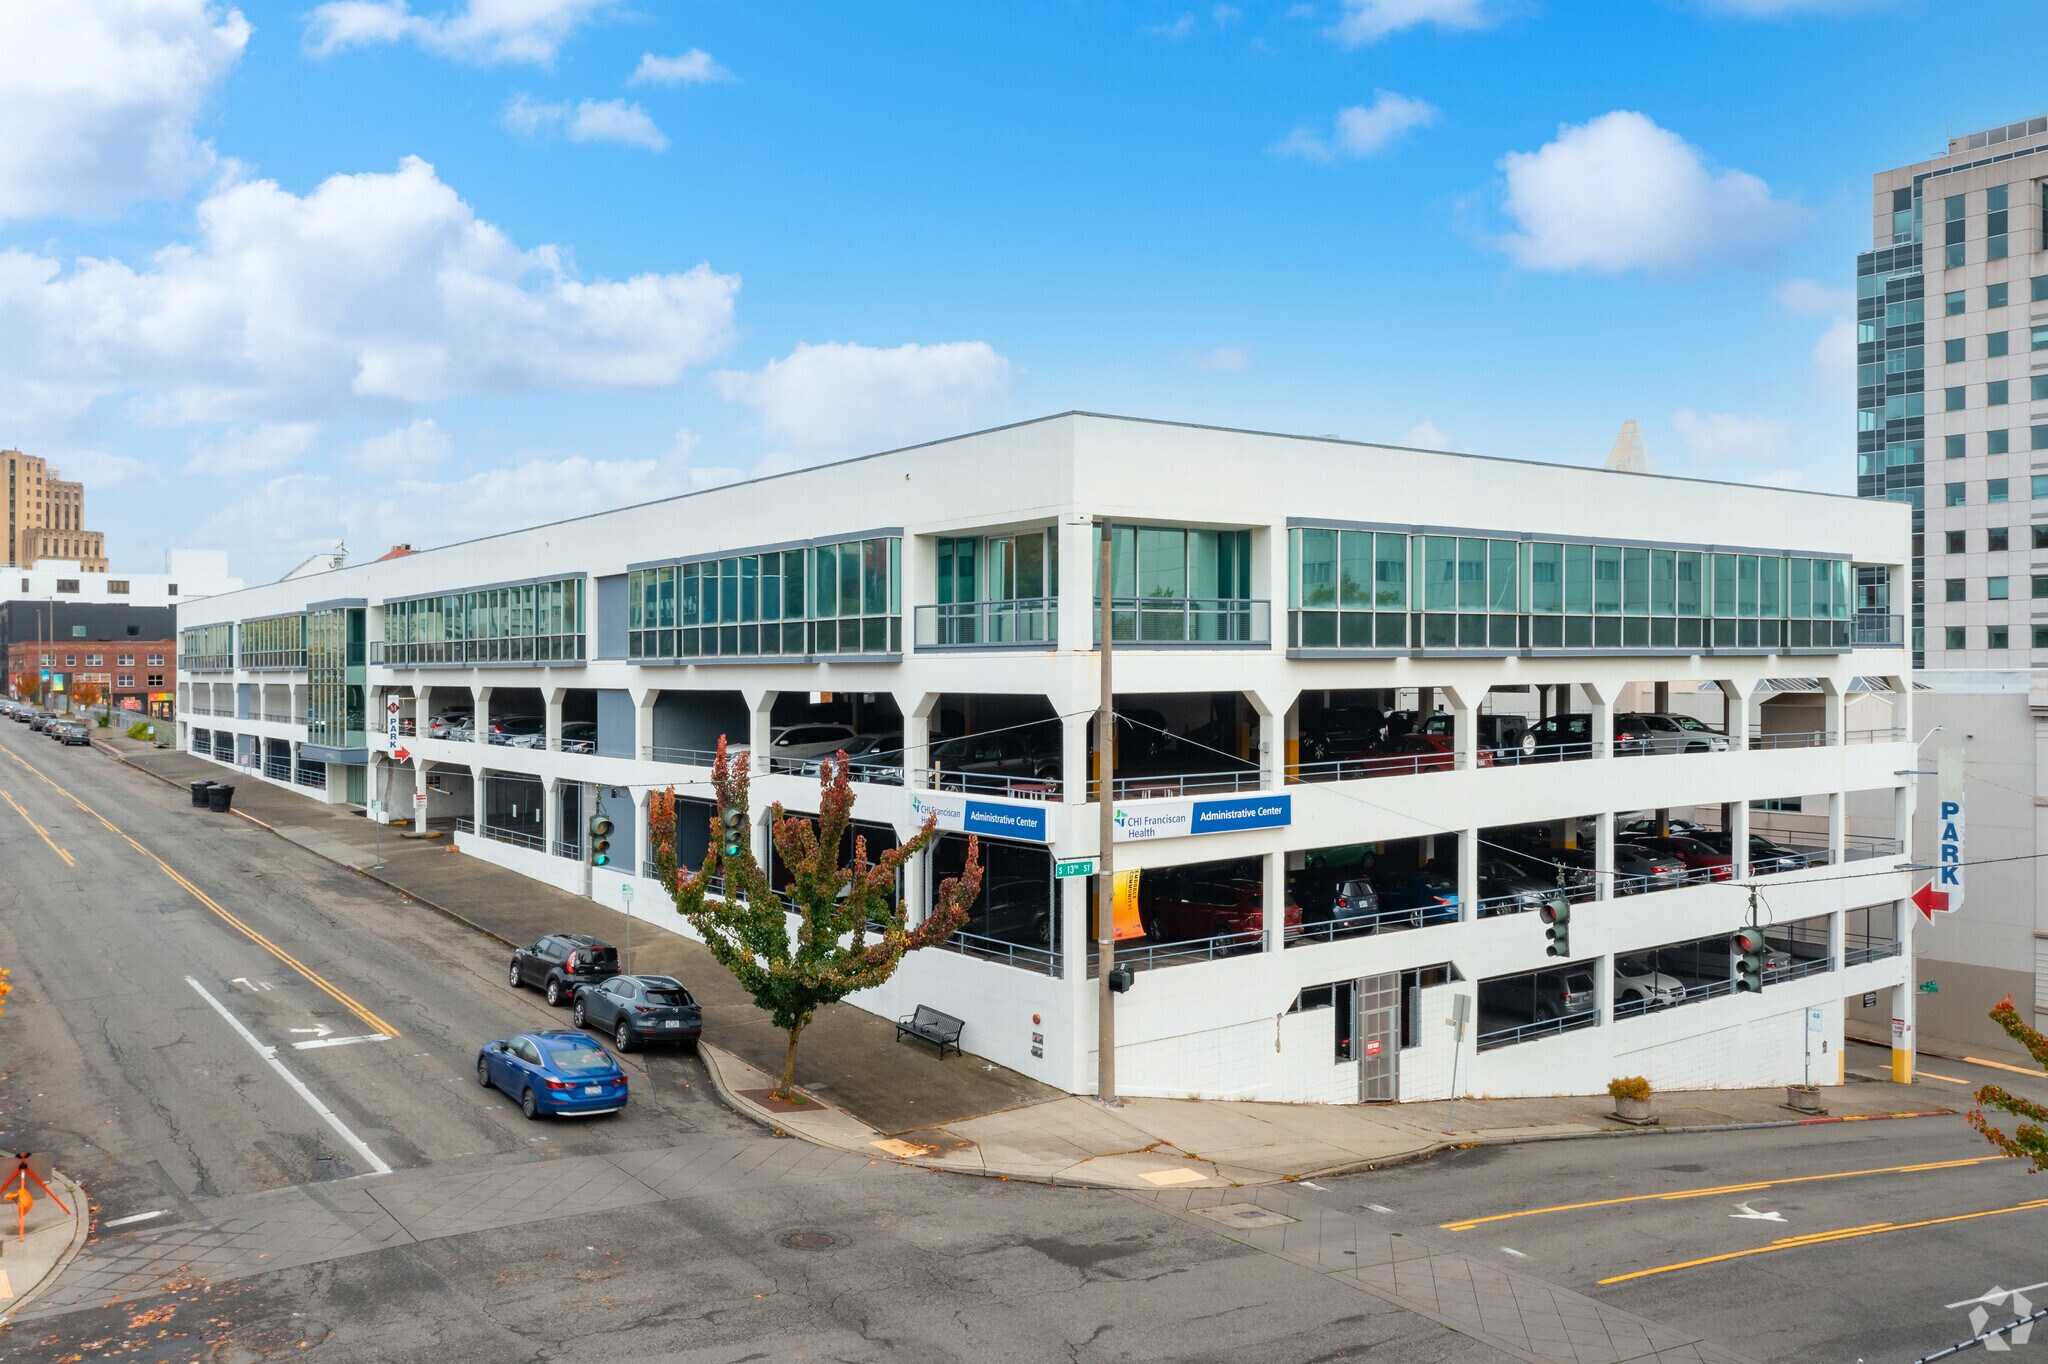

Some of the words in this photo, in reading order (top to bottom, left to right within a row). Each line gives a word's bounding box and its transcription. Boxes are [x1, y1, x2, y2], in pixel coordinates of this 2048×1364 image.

[389, 718, 397, 748] PARK
[970, 811, 1015, 826] Administrative
[1016, 816, 1038, 828] Center
[1127, 816, 1142, 827] CHI
[1144, 814, 1186, 826] Franciscan
[1200, 808, 1256, 822] Administrative
[1257, 806, 1283, 817] Center
[1128, 828, 1156, 839] Health
[1941, 801, 1960, 886] PARK
[1058, 866, 1063, 875] S
[1083, 864, 1091, 873] ST
